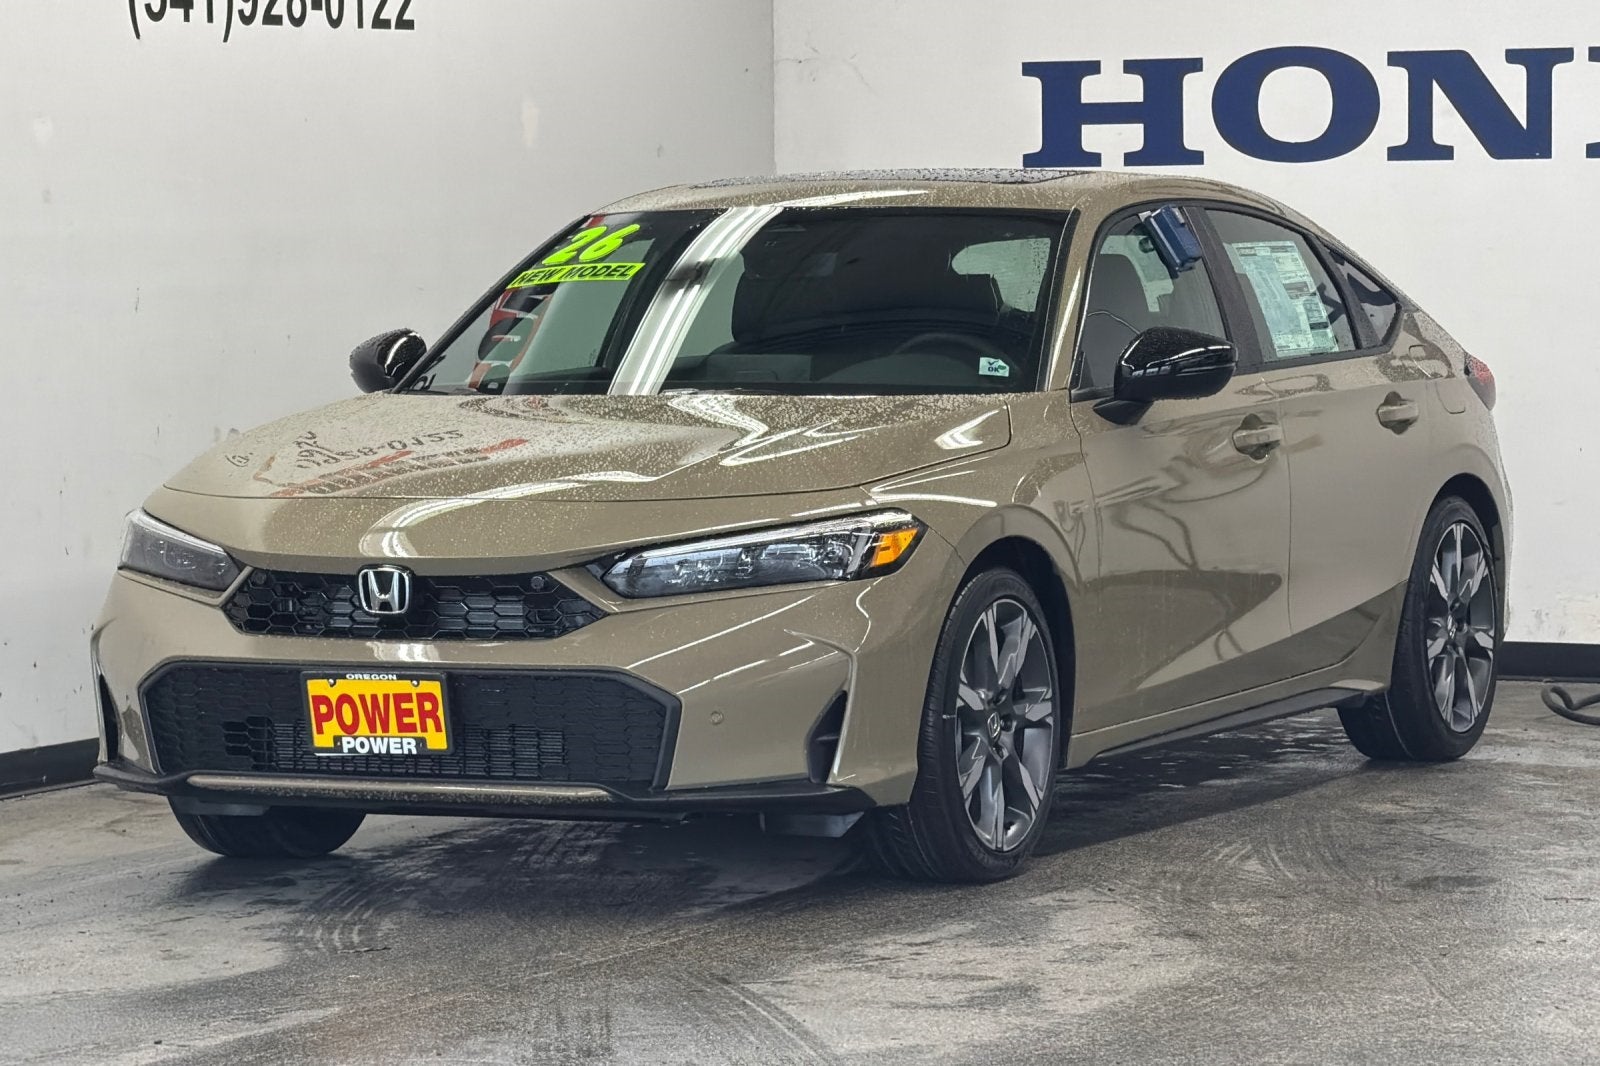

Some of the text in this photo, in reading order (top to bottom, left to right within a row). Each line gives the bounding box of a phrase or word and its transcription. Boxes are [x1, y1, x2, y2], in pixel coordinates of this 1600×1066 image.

[1022, 46, 1600, 168] HON
[542, 224, 640, 265] 26
[512, 264, 632, 285] NEW MODEL
[311, 692, 443, 735] POWER
[341, 737, 417, 754] POWER
